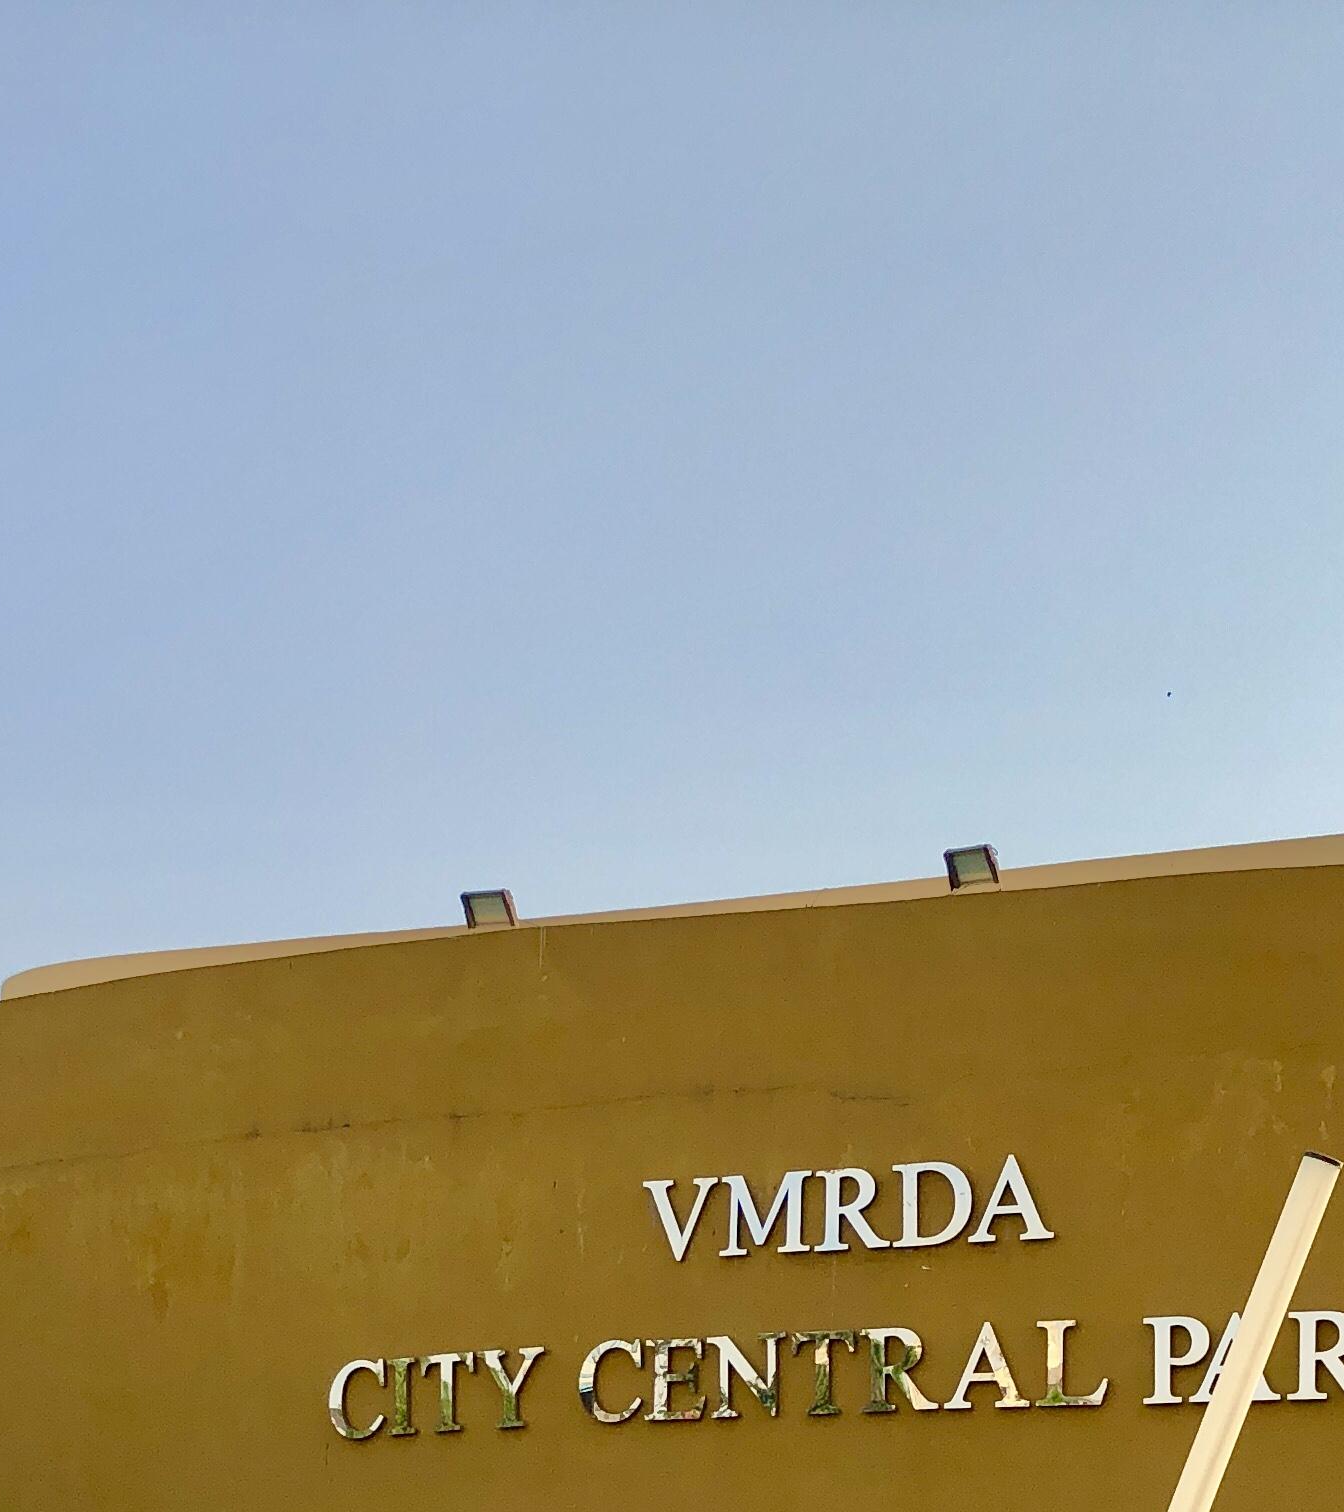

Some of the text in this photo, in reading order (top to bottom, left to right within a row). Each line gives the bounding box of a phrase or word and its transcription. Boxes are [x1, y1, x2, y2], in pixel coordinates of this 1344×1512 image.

[642, 1153, 1055, 1262] VMRDA
[328, 1346, 545, 1441] CITY
[577, 1320, 1108, 1424] CENTRAL
